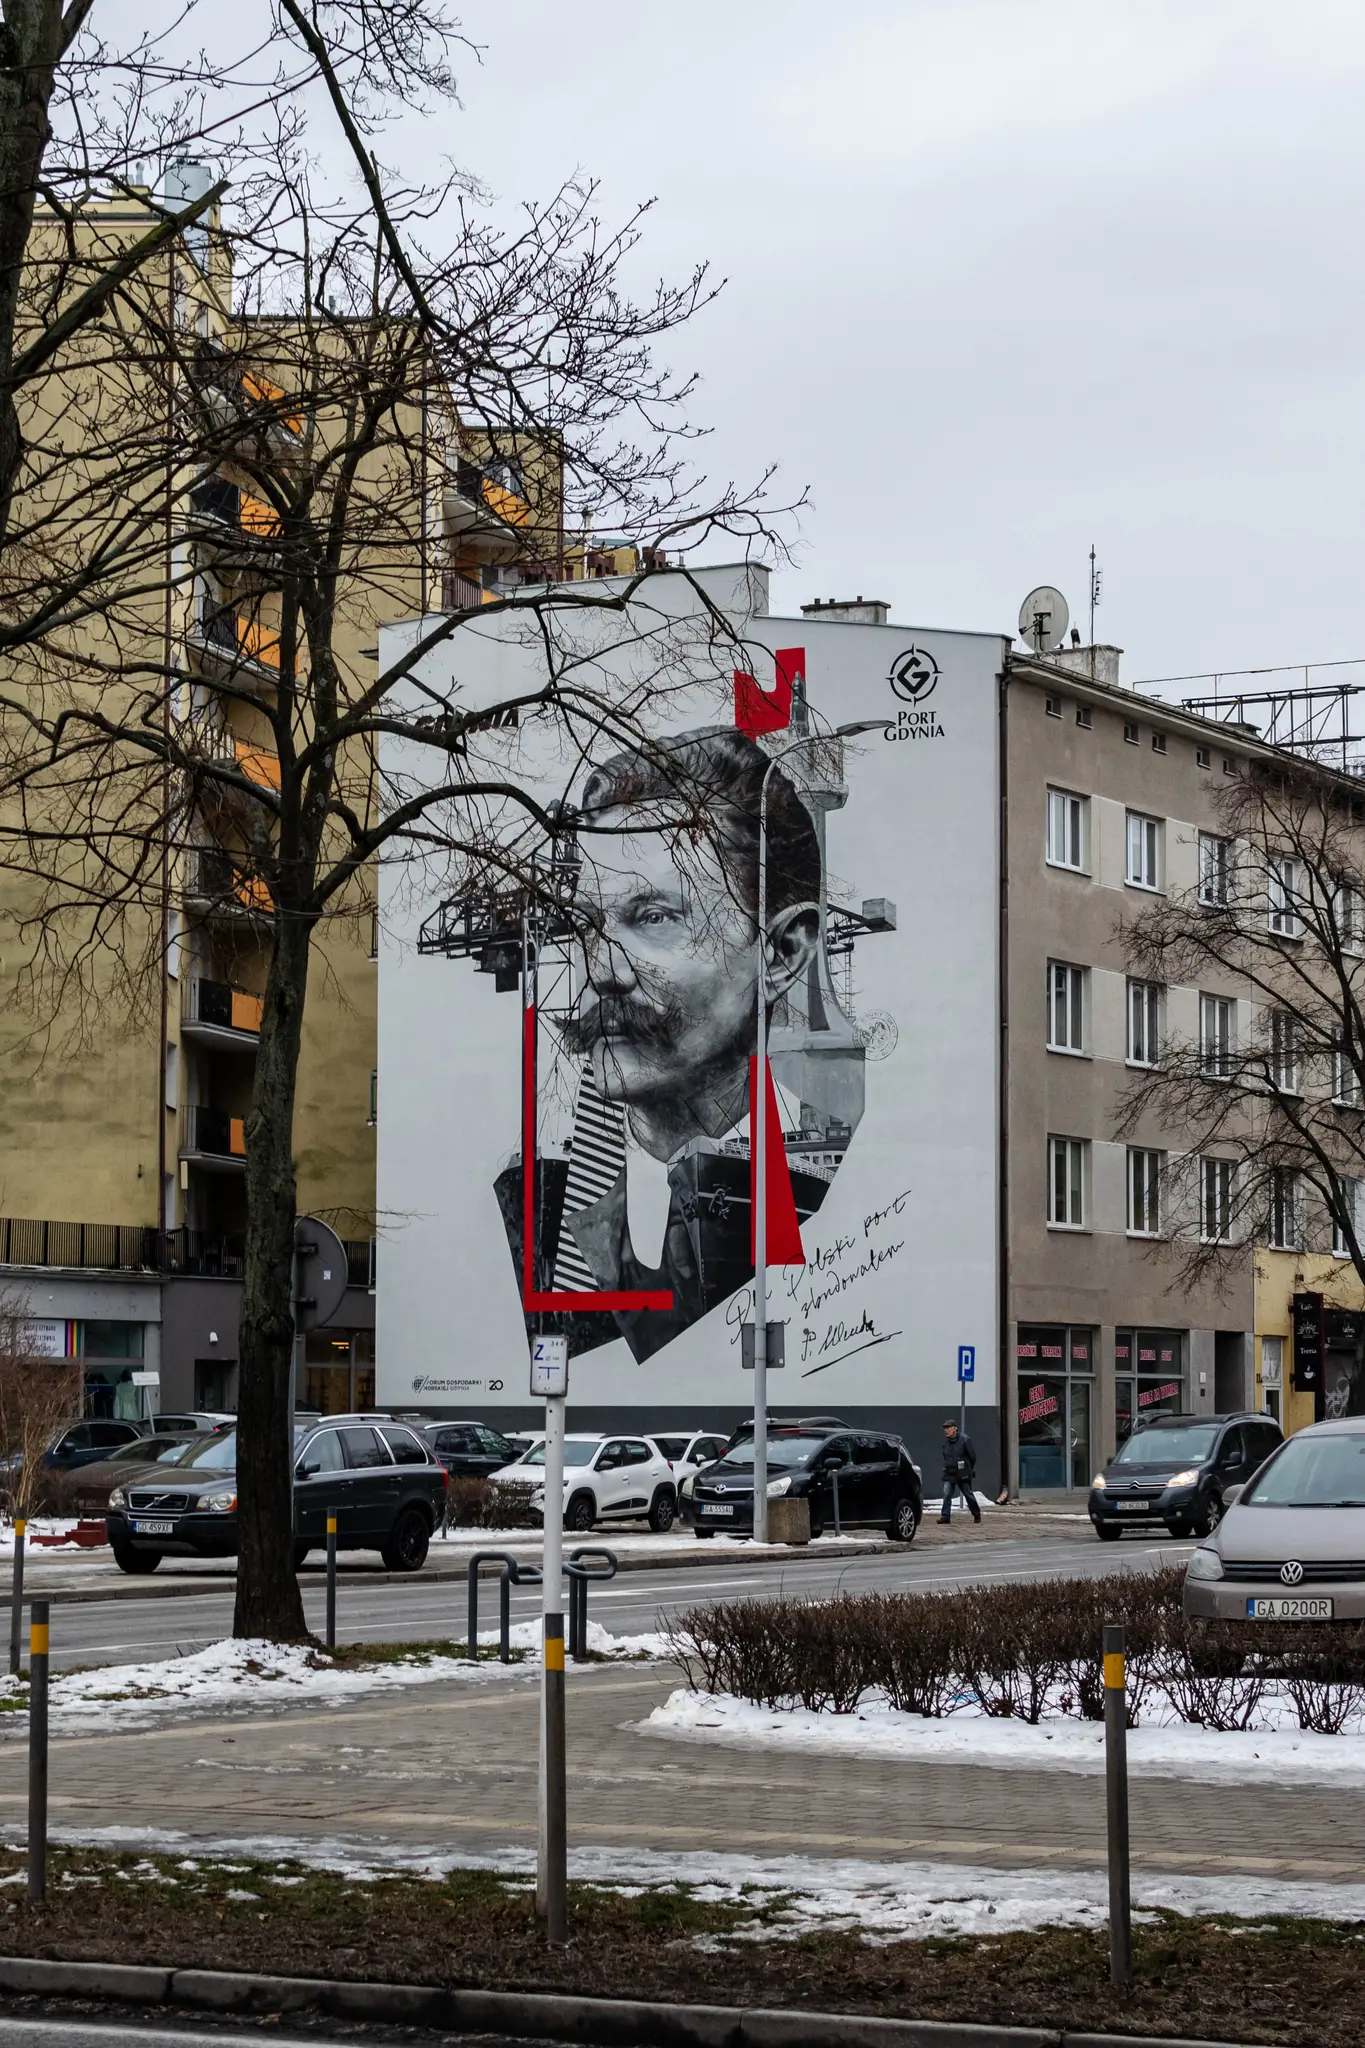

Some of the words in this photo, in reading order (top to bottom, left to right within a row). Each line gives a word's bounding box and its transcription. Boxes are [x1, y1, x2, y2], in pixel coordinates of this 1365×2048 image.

[898, 711, 937, 726] PORT
[884, 725, 945, 741] GDYNIA
[863, 1190, 911, 1237] port
[534, 1344, 544, 1360] Z
[488, 1379, 504, 1391] 20
[1029, 1383, 1045, 1404] CENY
[1019, 1396, 1058, 1425] PRODUCENTA
[1257, 1601, 1275, 1616] GA
[1281, 1601, 1328, 1616] 0200R
